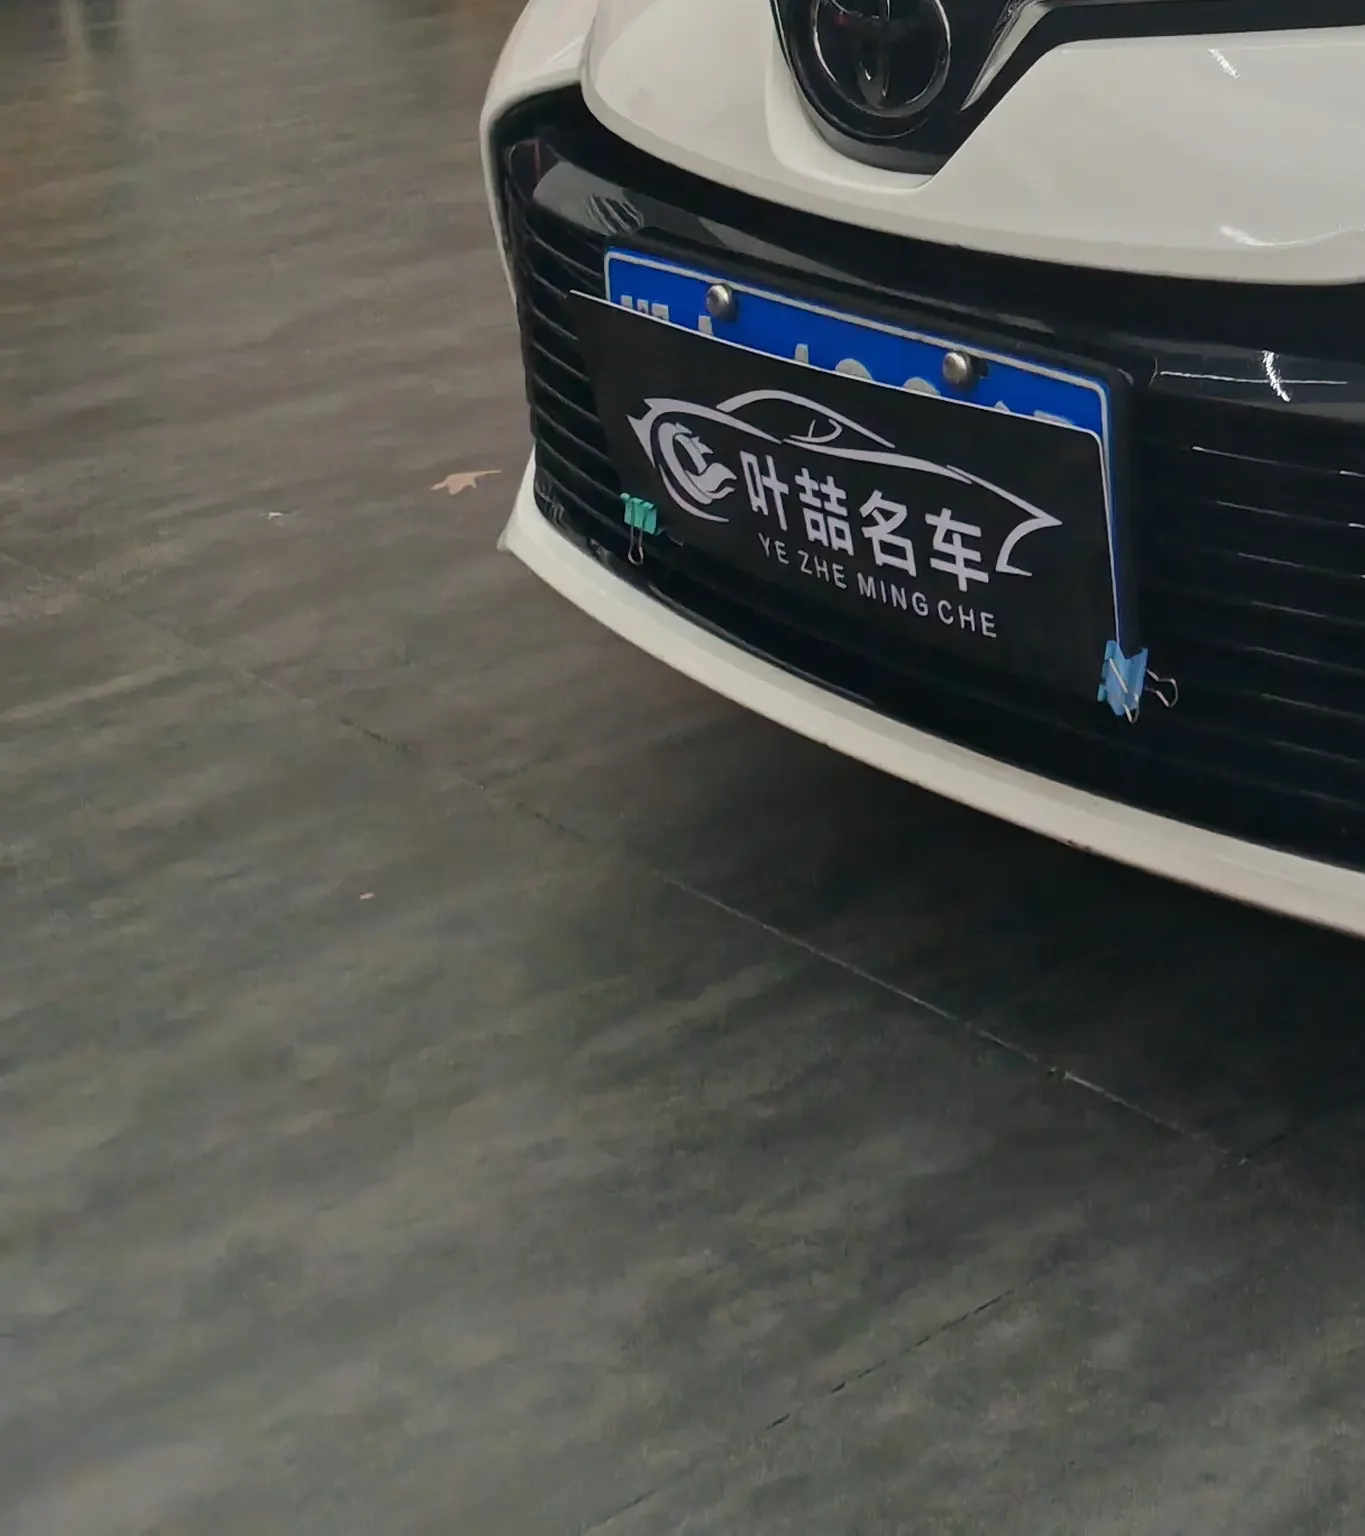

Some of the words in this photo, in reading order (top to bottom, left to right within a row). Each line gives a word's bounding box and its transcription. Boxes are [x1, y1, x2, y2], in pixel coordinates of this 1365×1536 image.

[739, 449, 991, 592] 叶喆名车
[757, 532, 790, 565] YE
[799, 549, 848, 591] ZHE
[857, 570, 930, 618] MING
[936, 598, 998, 639] CHE
